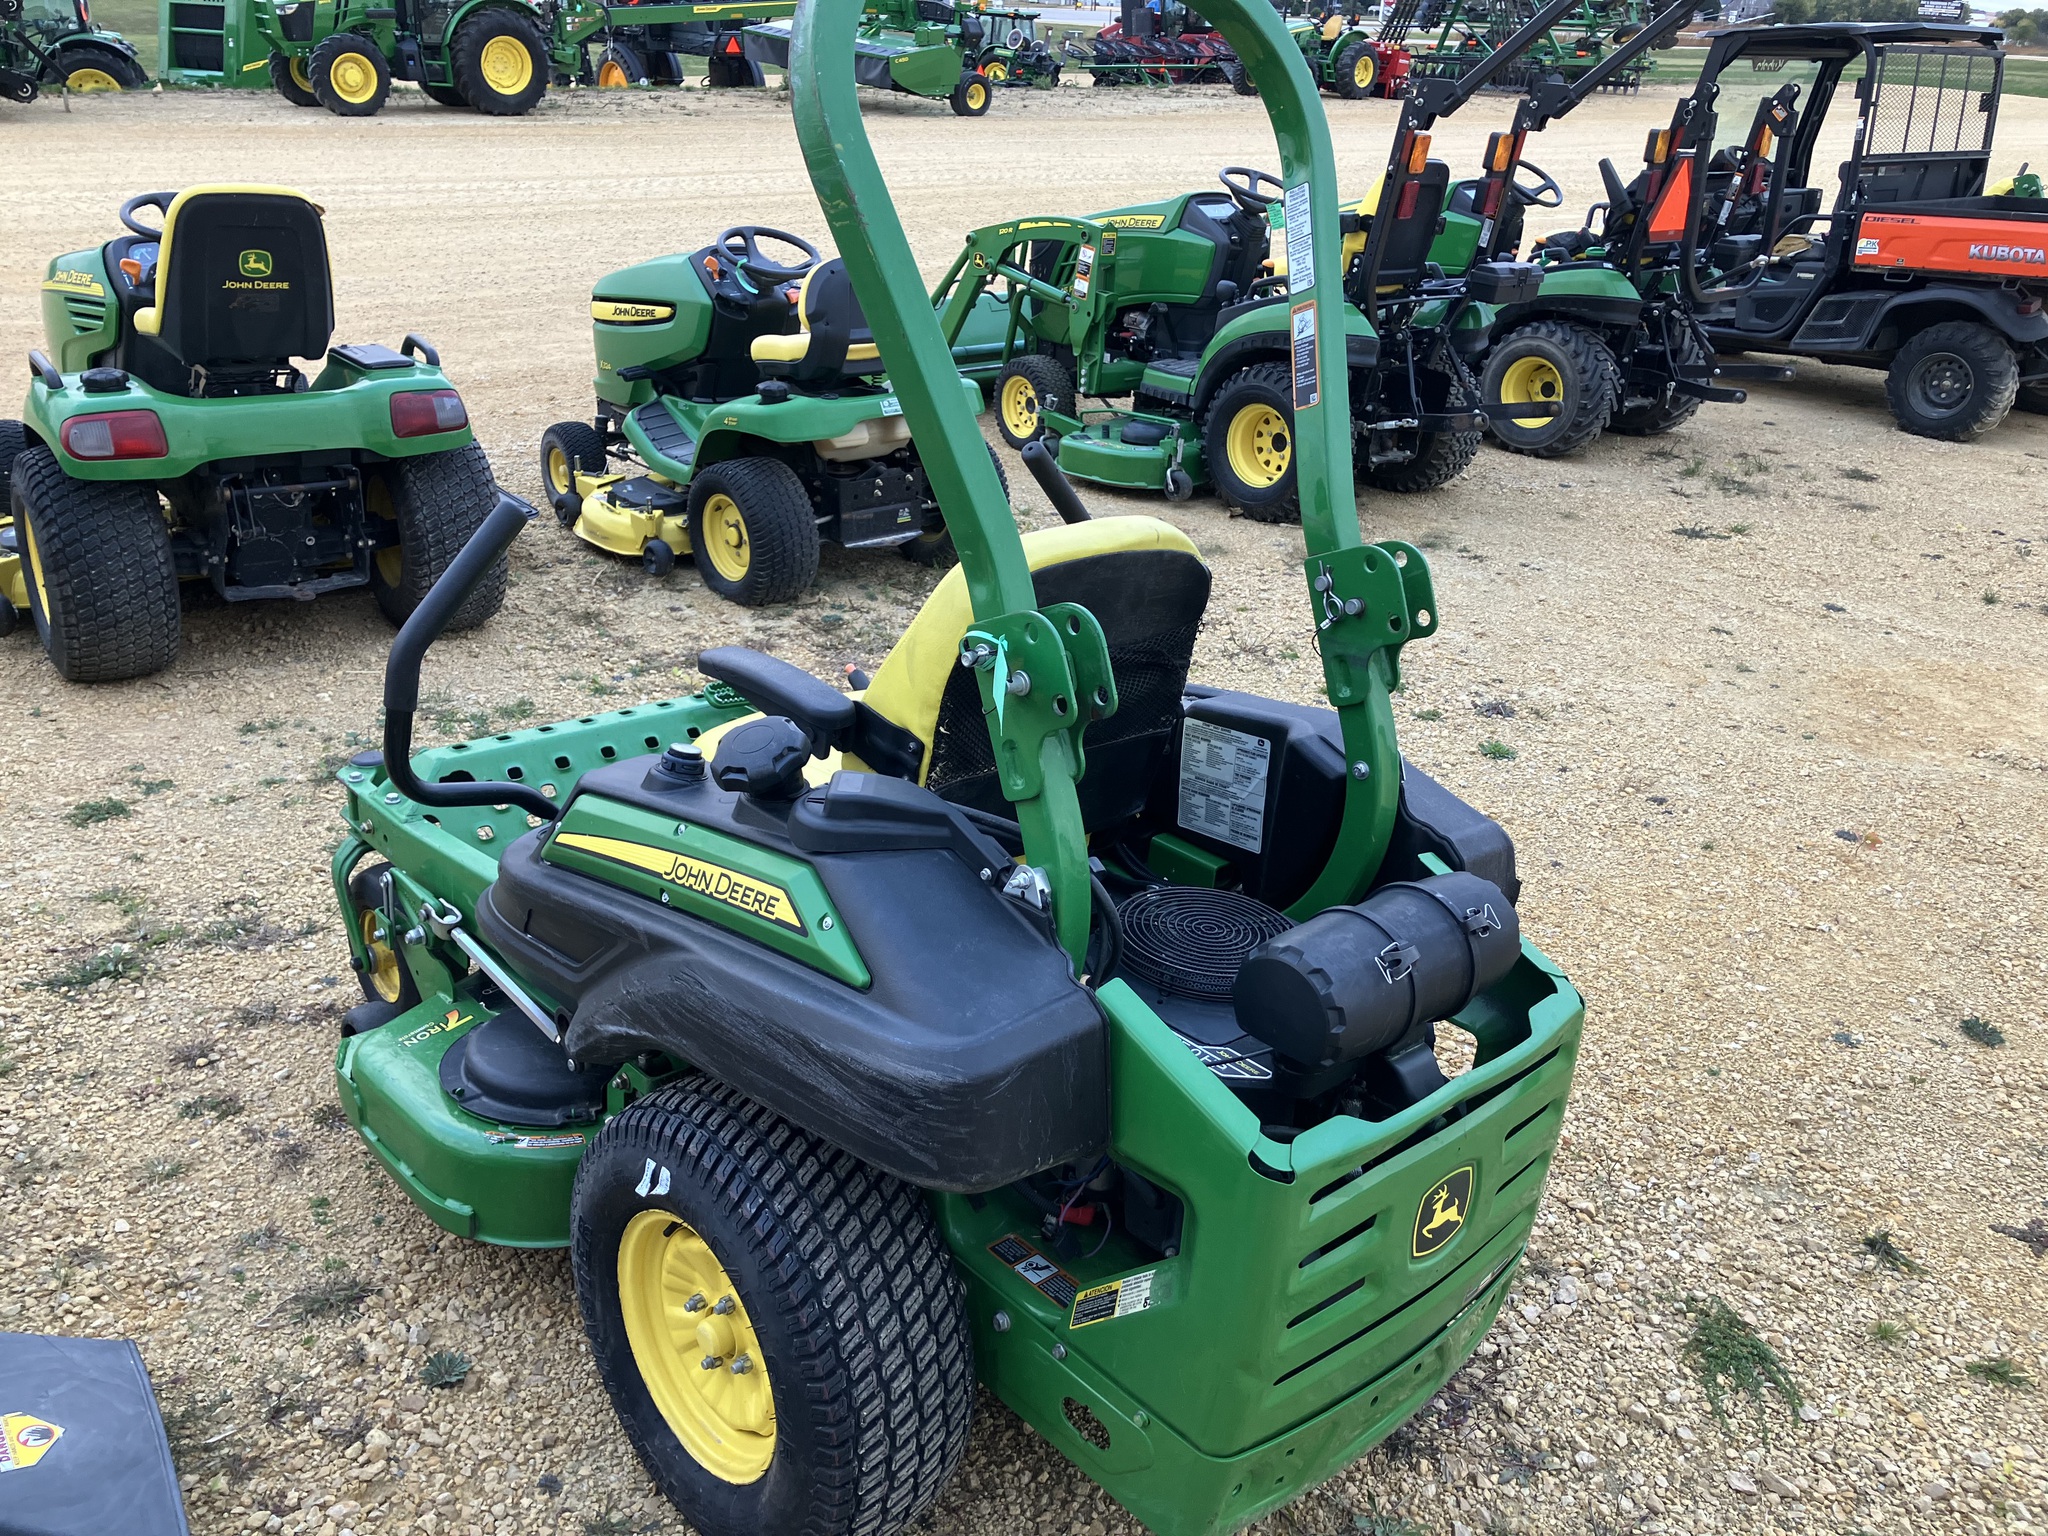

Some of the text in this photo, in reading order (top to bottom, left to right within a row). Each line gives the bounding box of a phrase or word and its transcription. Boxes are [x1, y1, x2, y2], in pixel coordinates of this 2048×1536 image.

[1128, 217, 1158, 227] DEERE
[1865, 216, 1920, 225] DIESEL
[1969, 244, 2046, 264] KUBOTA
[53, 269, 93, 286] JOHN DEERE
[222, 280, 290, 289] JOHN DEERE
[612, 305, 656, 317] JOHN DEERE
[663, 856, 780, 916] JOHN DEERE
